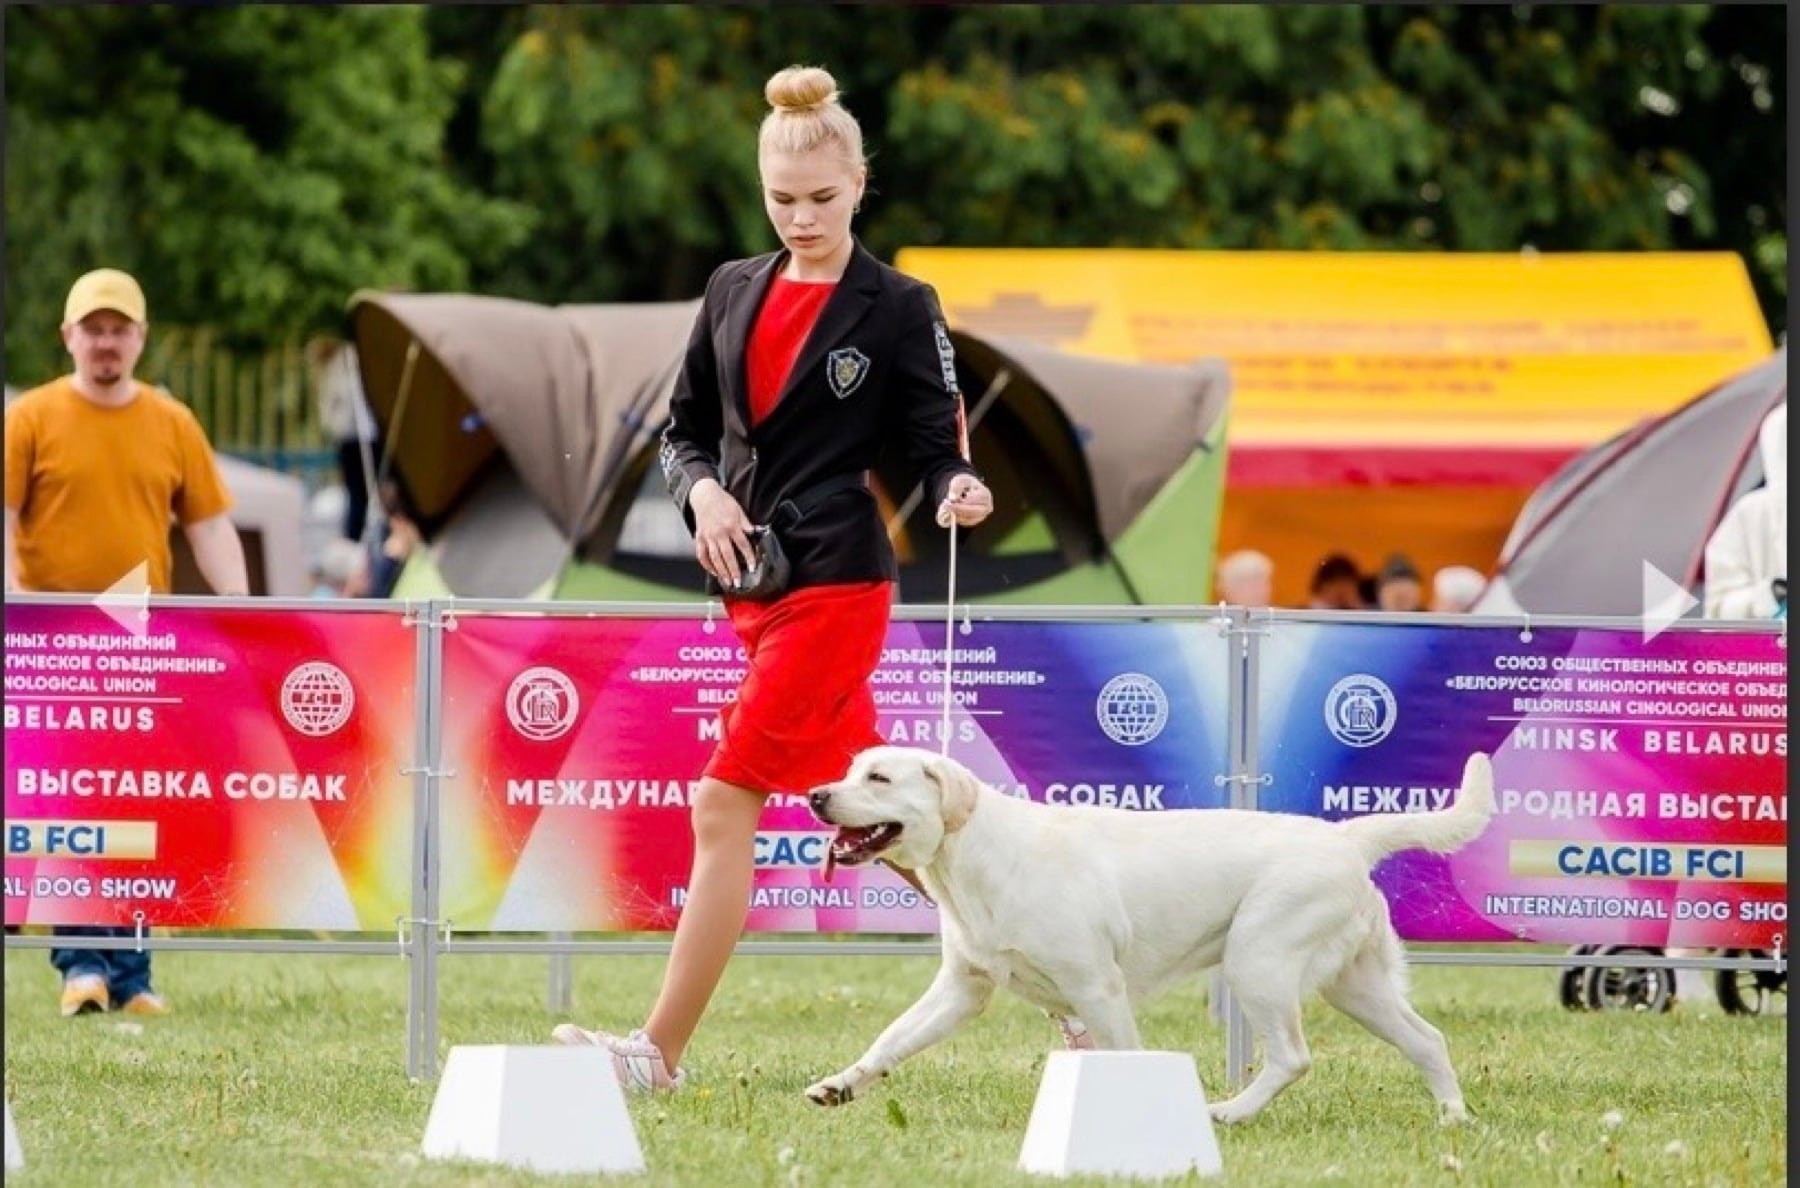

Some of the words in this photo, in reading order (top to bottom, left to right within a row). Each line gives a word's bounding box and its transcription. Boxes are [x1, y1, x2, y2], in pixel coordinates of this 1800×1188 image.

[53, 634, 176, 651] ОБЪЕДИНЕНИЙ
[678, 647, 732, 661] СОЮЗ
[630, 667, 746, 682] «БЕЛОРУССКО
[1495, 656, 1548, 671] СОЮЗ
[1551, 658, 1688, 674] ОБЩЕСТВЕННЫХ
[104, 678, 156, 692] UNION
[926, 691, 978, 705] UNON
[1513, 698, 1621, 713] BELORUSSIAN
[1626, 702, 1737, 717] CINOLOGICAL
[5, 705, 154, 730] BELARUS
[1513, 729, 1619, 752] MINSK
[1644, 731, 1788, 756] BELARUS
[17, 769, 211, 797] ВЫСТАВКА
[224, 773, 346, 800] СОБАК
[1045, 784, 1165, 809] СОБАК
[46, 826, 105, 853] FCI
[1558, 846, 1673, 876] CACIB
[1687, 849, 1744, 878] FCI
[35, 878, 92, 897] DOG
[101, 879, 176, 898] SHOW
[863, 889, 918, 907] DOG
[1486, 895, 1668, 918] INTERNATIONAL
[1676, 901, 1730, 919] DOG
